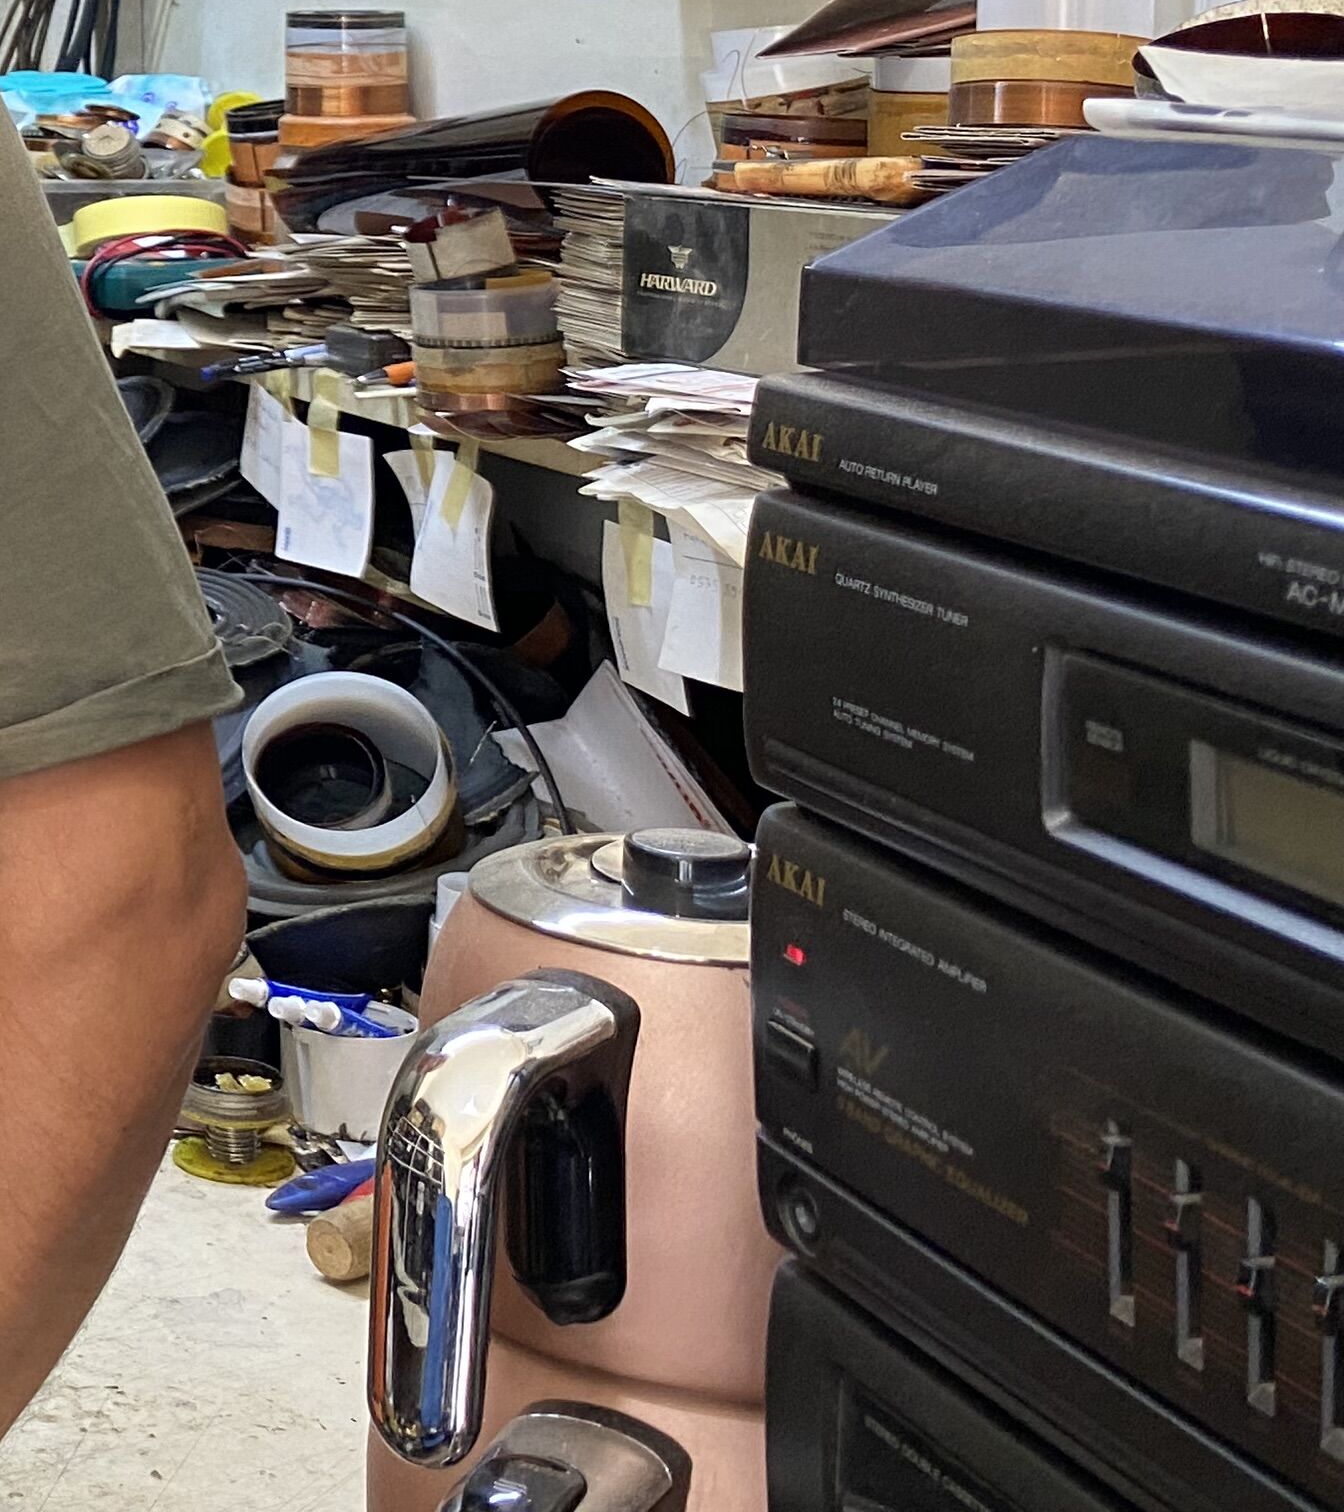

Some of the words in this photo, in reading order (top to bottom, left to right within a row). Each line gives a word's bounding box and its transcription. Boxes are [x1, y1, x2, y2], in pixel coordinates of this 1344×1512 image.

[639, 273, 718, 297] HARWARD
[762, 421, 824, 463] AKAI
[838, 458, 864, 476] AUTO
[864, 465, 901, 486] RETURN
[902, 475, 939, 496] PLAYER
[758, 530, 821, 576] AKAI
[834, 572, 872, 595] QUARTZ
[873, 585, 934, 617] SYNTHESIZER
[936, 606, 969, 628] TUNER
[766, 854, 826, 909] AKAI
[842, 908, 877, 936] STEREO
